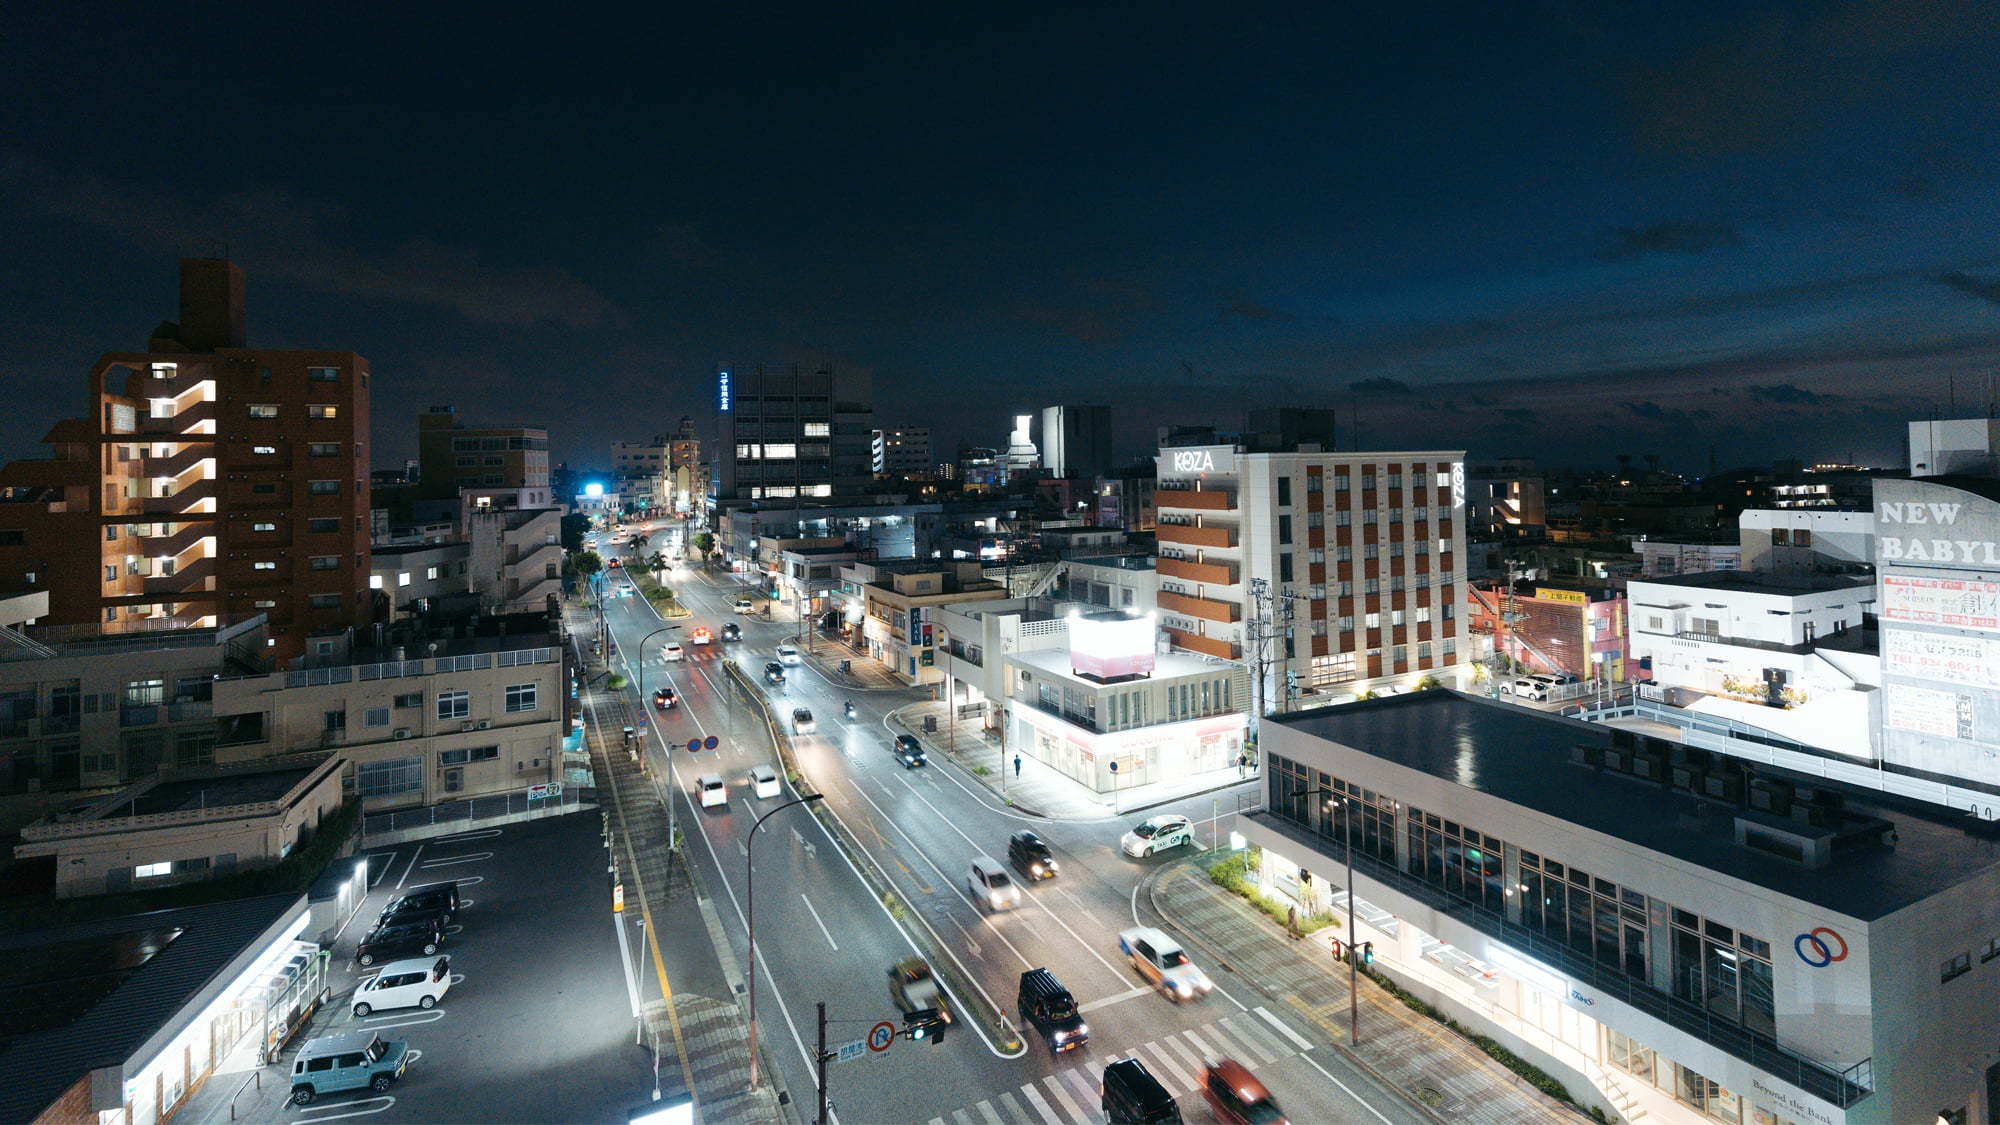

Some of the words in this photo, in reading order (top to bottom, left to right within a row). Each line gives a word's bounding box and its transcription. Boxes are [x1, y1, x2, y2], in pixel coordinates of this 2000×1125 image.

[1174, 450, 1215, 471] KOZA
[1452, 462, 1465, 509] KOZA
[1880, 502, 1961, 525] NEW
[1881, 537, 2000, 564] BABYL
[1752, 1079, 1786, 1103] Beyond
[1808, 1107, 1833, 1125] Bank
